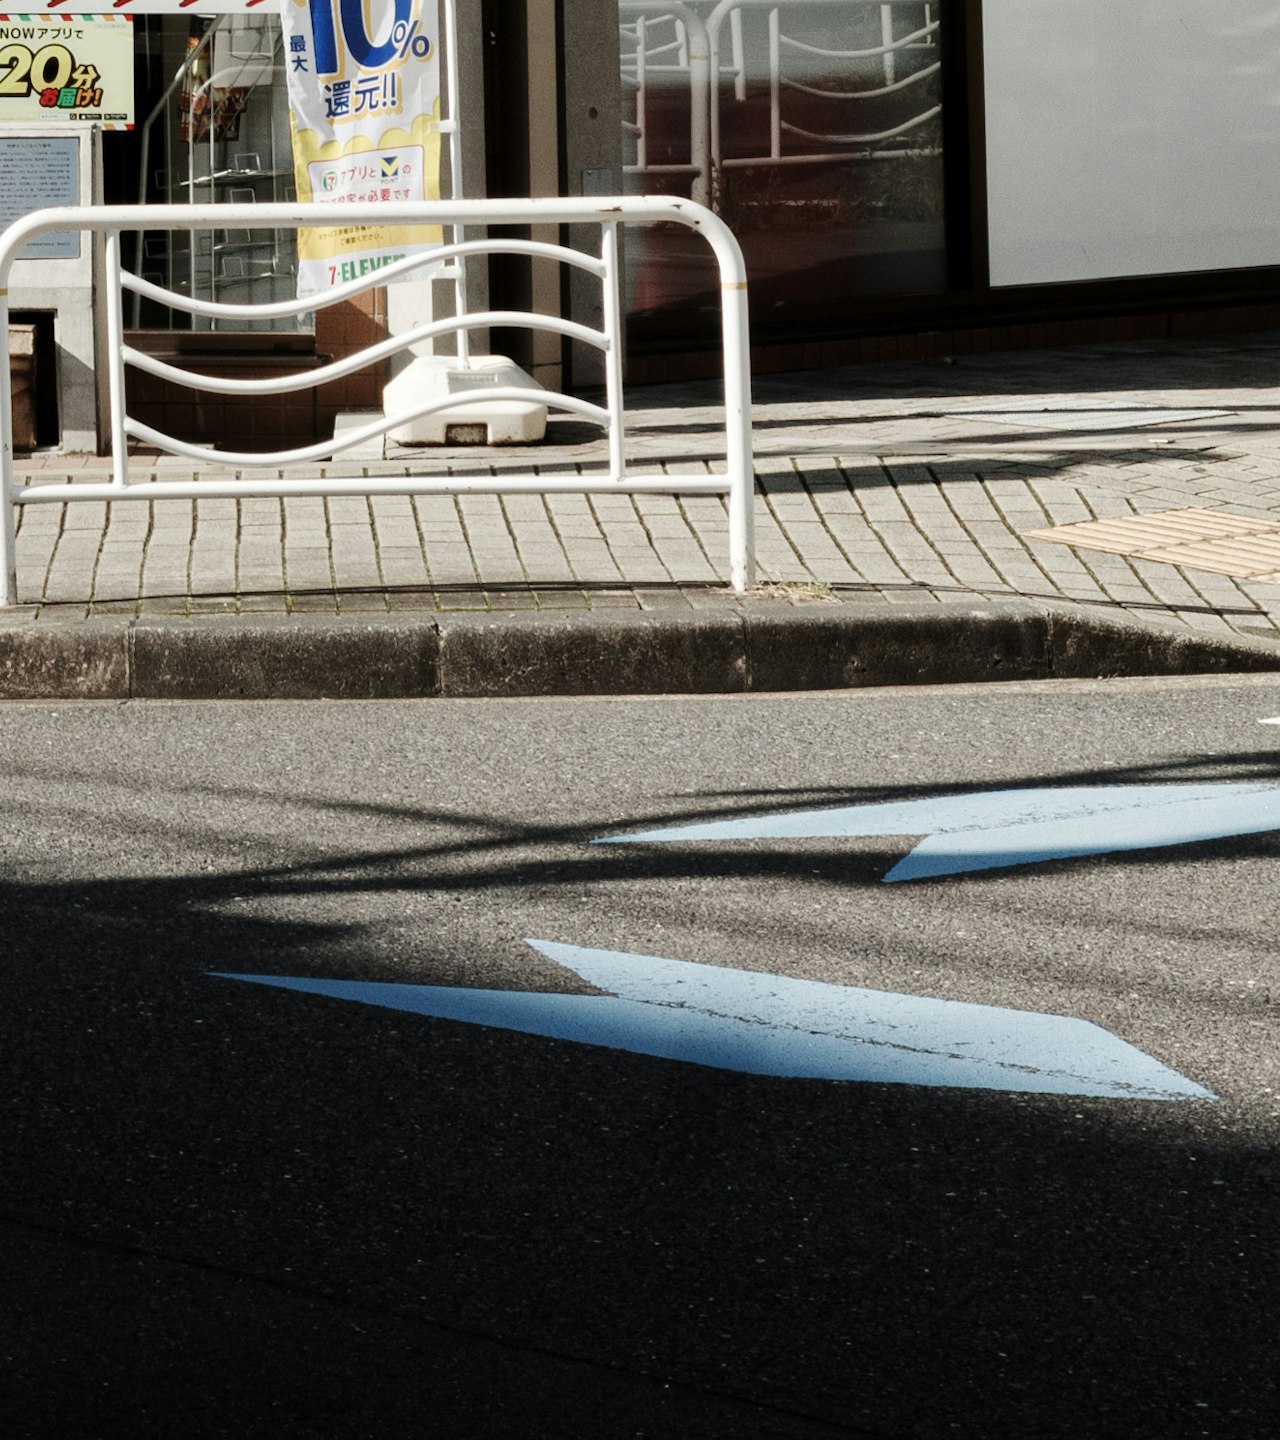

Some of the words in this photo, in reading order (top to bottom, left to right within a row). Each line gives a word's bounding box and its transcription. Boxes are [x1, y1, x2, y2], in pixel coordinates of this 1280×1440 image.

[289, 35, 309, 73] 最大
[38, 86, 105, 109] お届け!
[340, 167, 378, 185] アプリと
